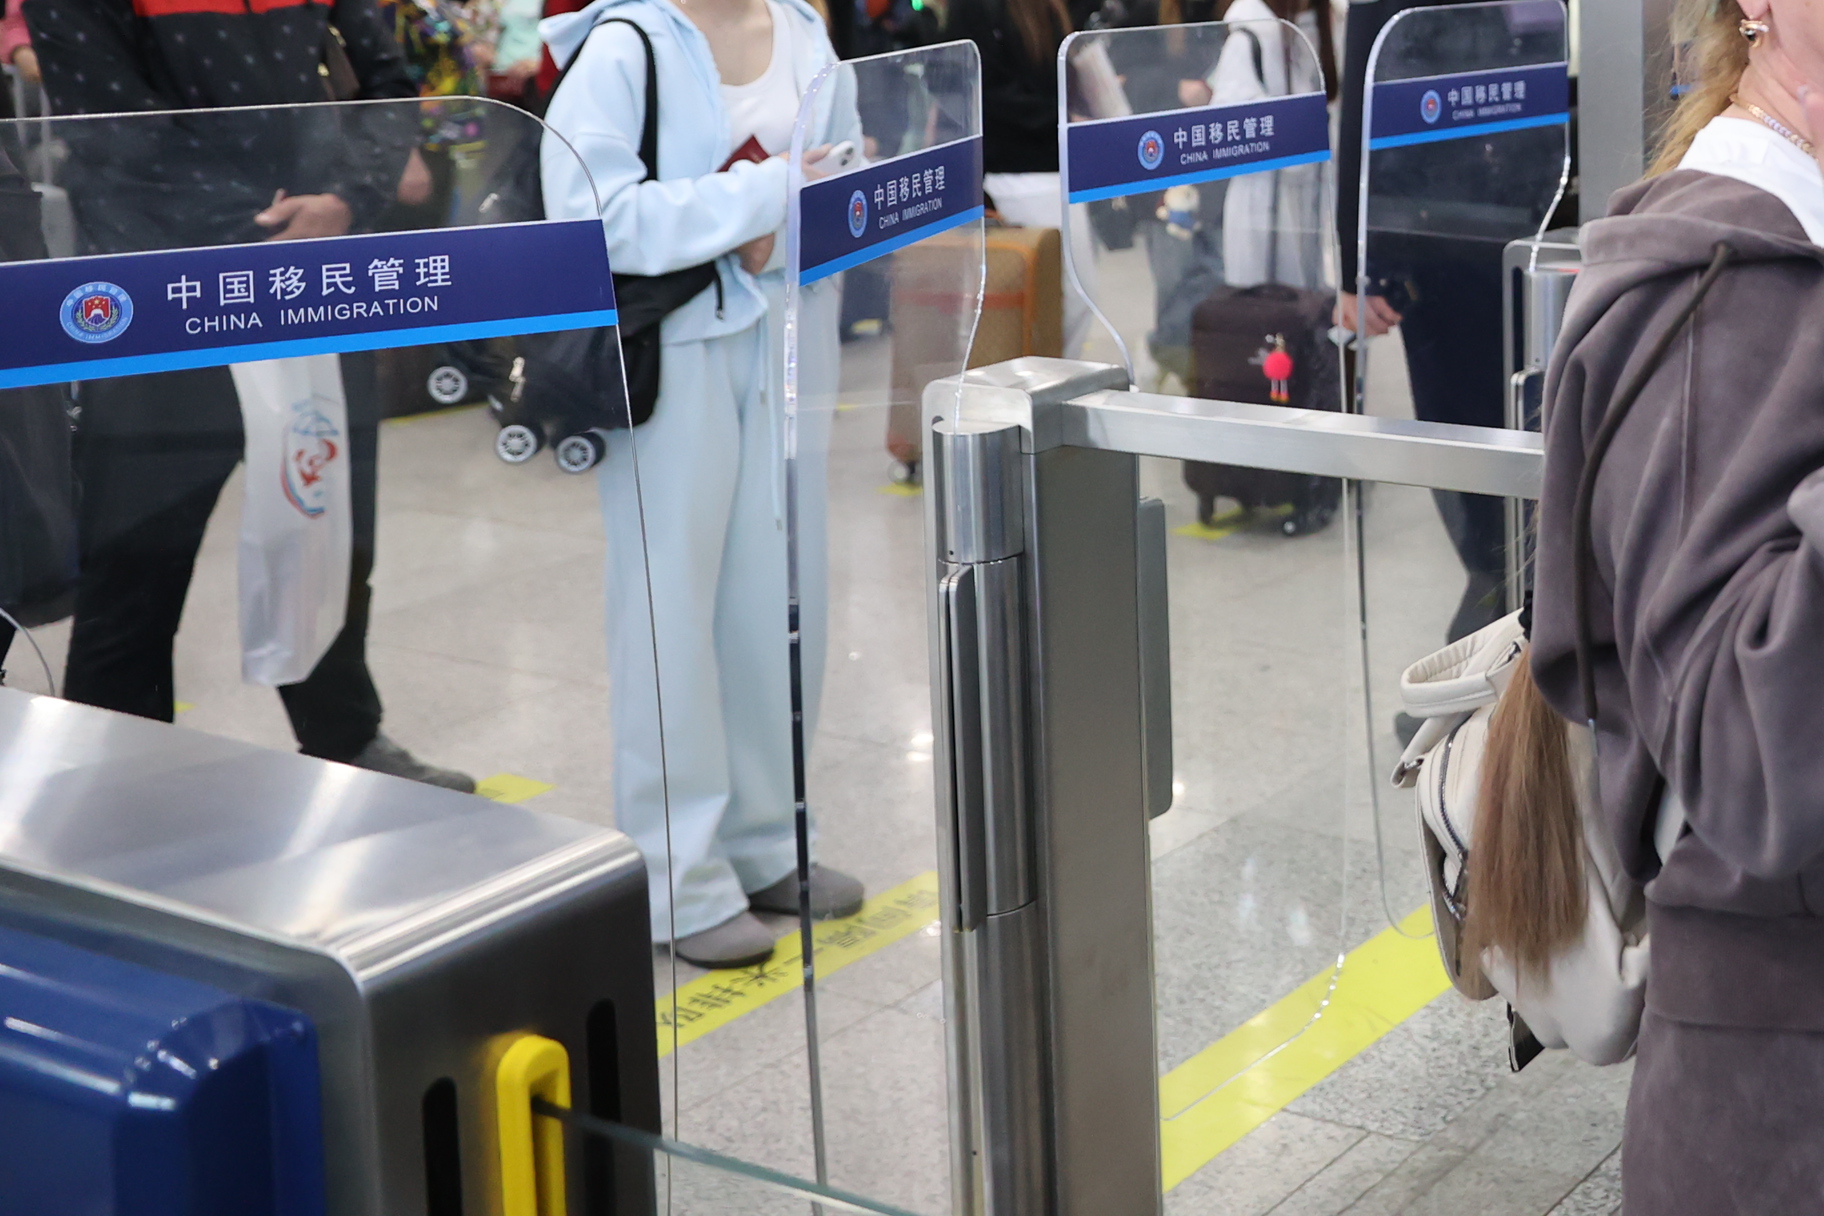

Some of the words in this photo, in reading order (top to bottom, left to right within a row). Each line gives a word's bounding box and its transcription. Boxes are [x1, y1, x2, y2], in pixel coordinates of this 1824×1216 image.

[1174, 115, 1275, 149] 中国移民管理
[1180, 151, 1209, 165] CHINA
[1213, 141, 1270, 159] IMMIGRATION
[874, 166, 946, 210] 中国移民管理
[879, 212, 899, 229] CHINA
[902, 197, 943, 221] IMMIGRATION
[167, 255, 452, 310] 中国移民管理
[185, 312, 263, 334] CHINA
[280, 295, 439, 325] IMMIGRATION
